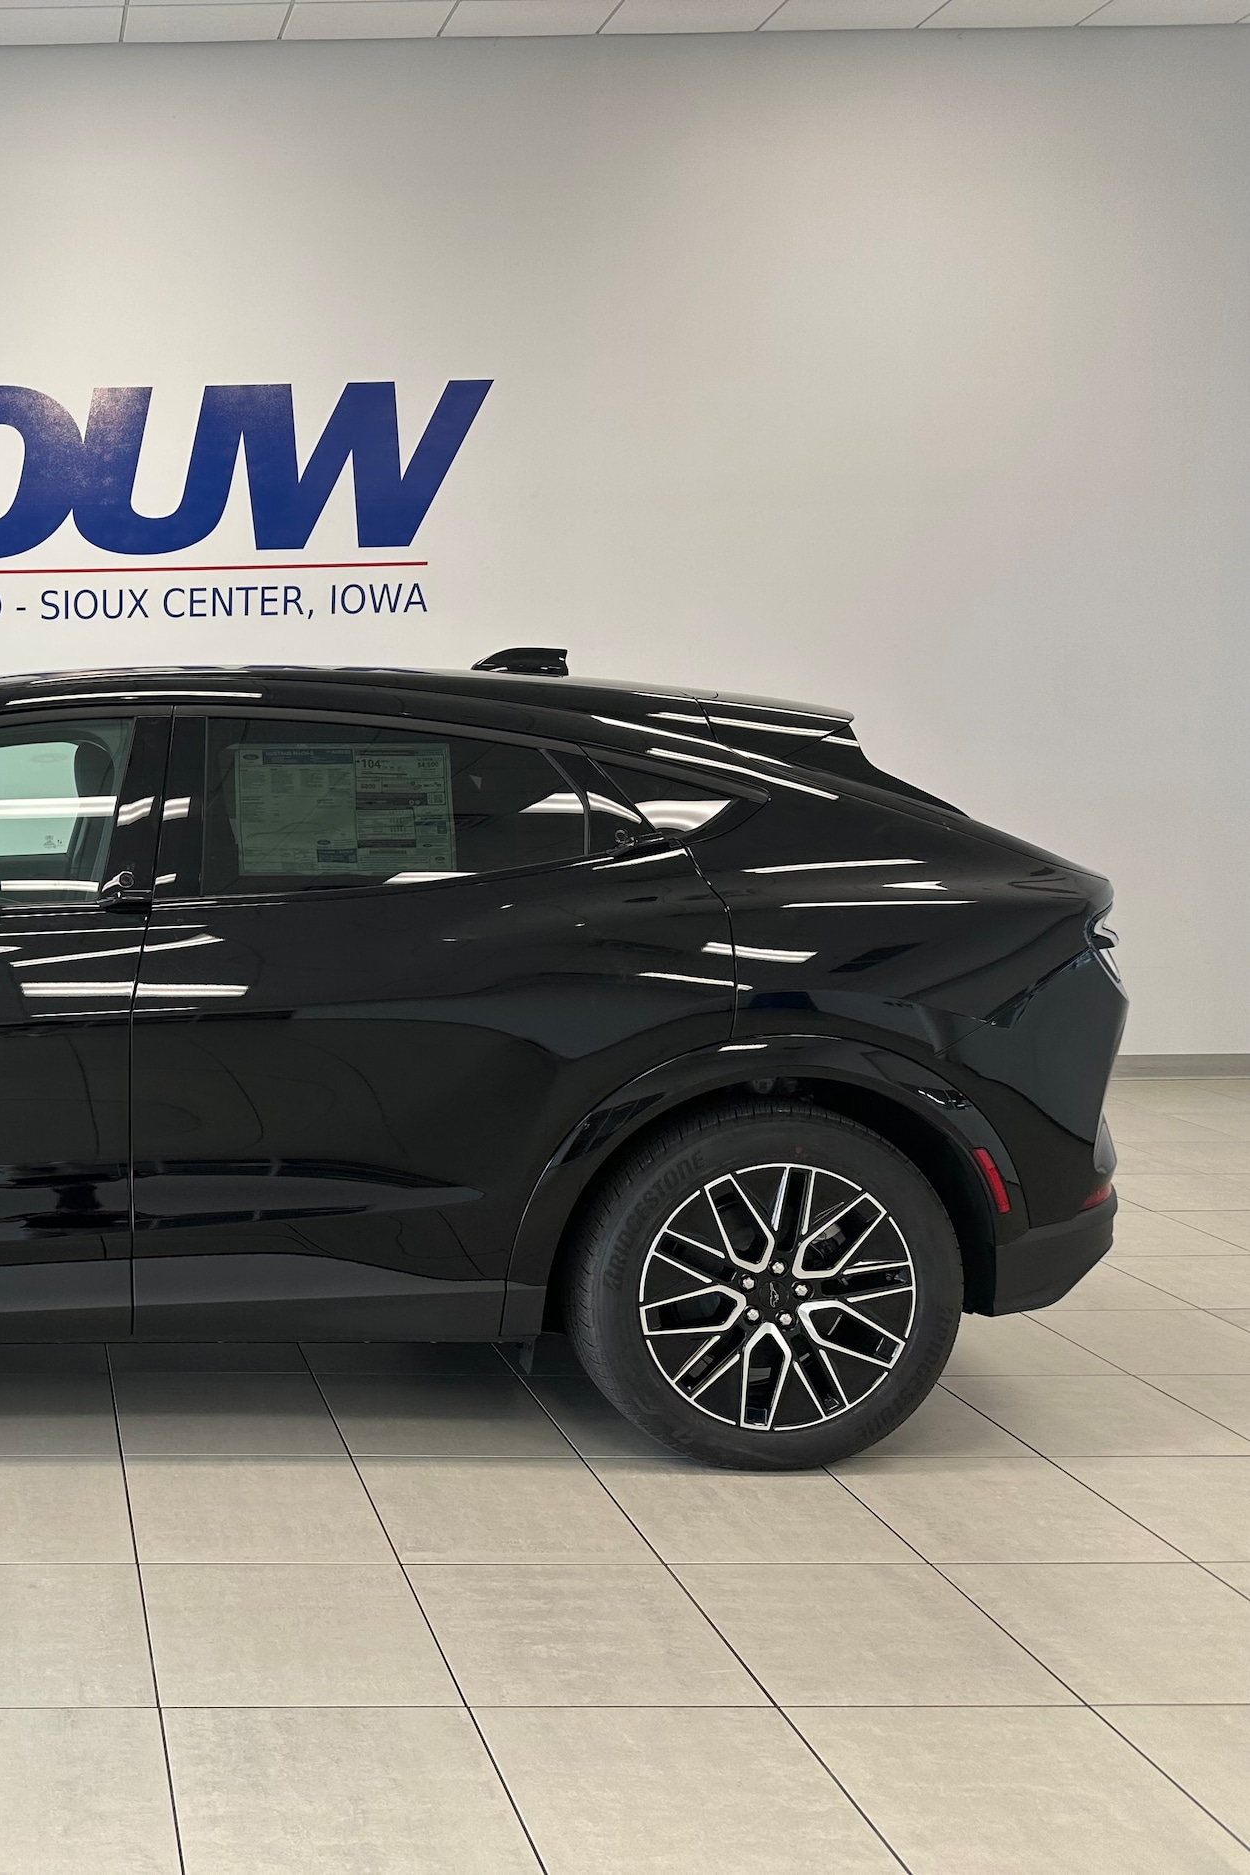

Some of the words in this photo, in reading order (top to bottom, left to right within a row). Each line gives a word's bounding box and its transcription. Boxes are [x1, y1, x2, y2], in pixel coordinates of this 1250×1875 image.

[39, 588, 148, 620] SIOUX
[163, 584, 313, 619] CENTER,
[331, 582, 427, 614] IOWA
[361, 758, 381, 769] 104
[603, 1149, 706, 1290] BRIDGESTONE
